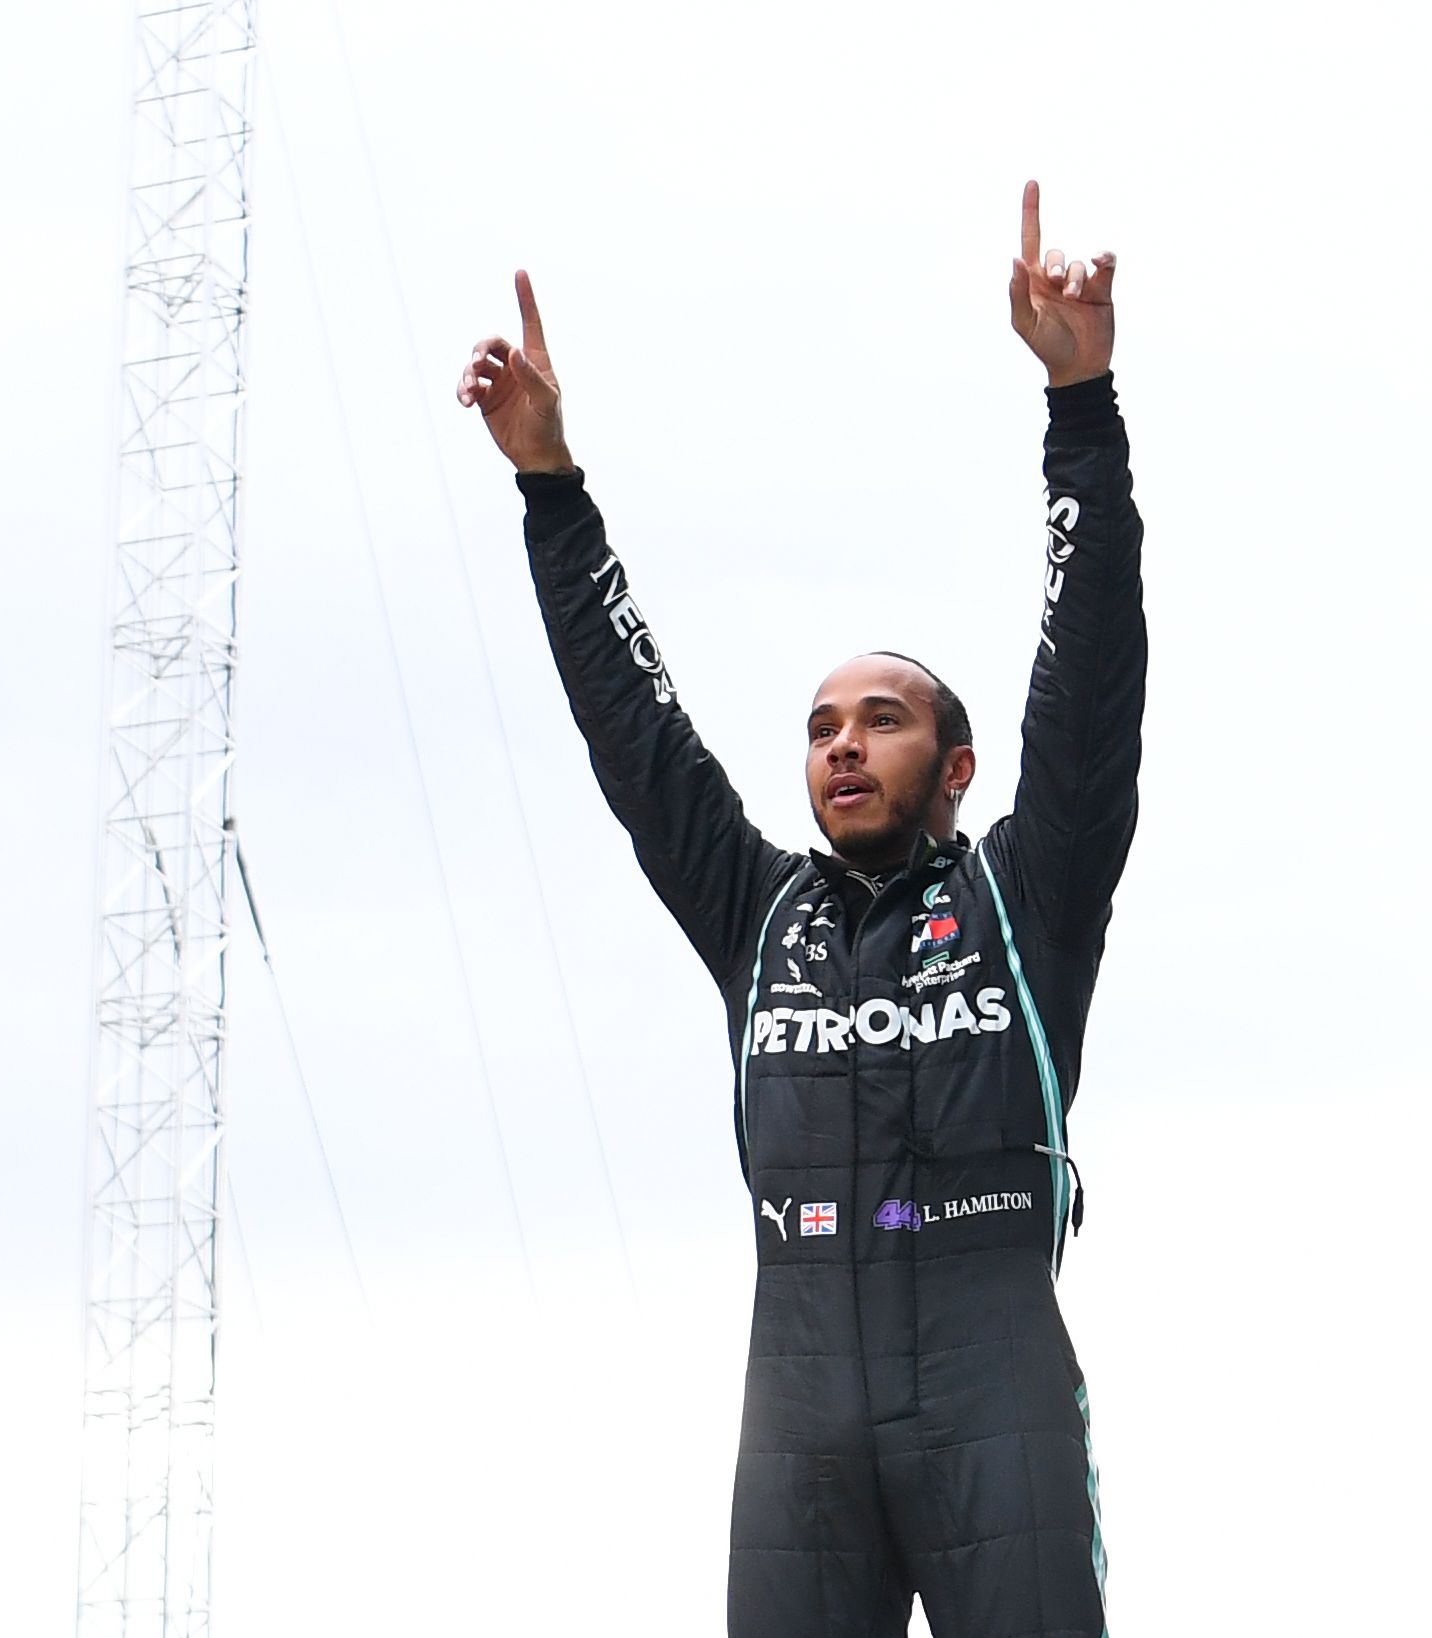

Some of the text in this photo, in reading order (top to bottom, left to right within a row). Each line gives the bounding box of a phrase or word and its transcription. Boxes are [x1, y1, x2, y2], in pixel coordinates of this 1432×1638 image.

[750, 986, 1013, 1057] PETRONAS
[872, 1192, 1033, 1232] 44 L. HAMILTON
